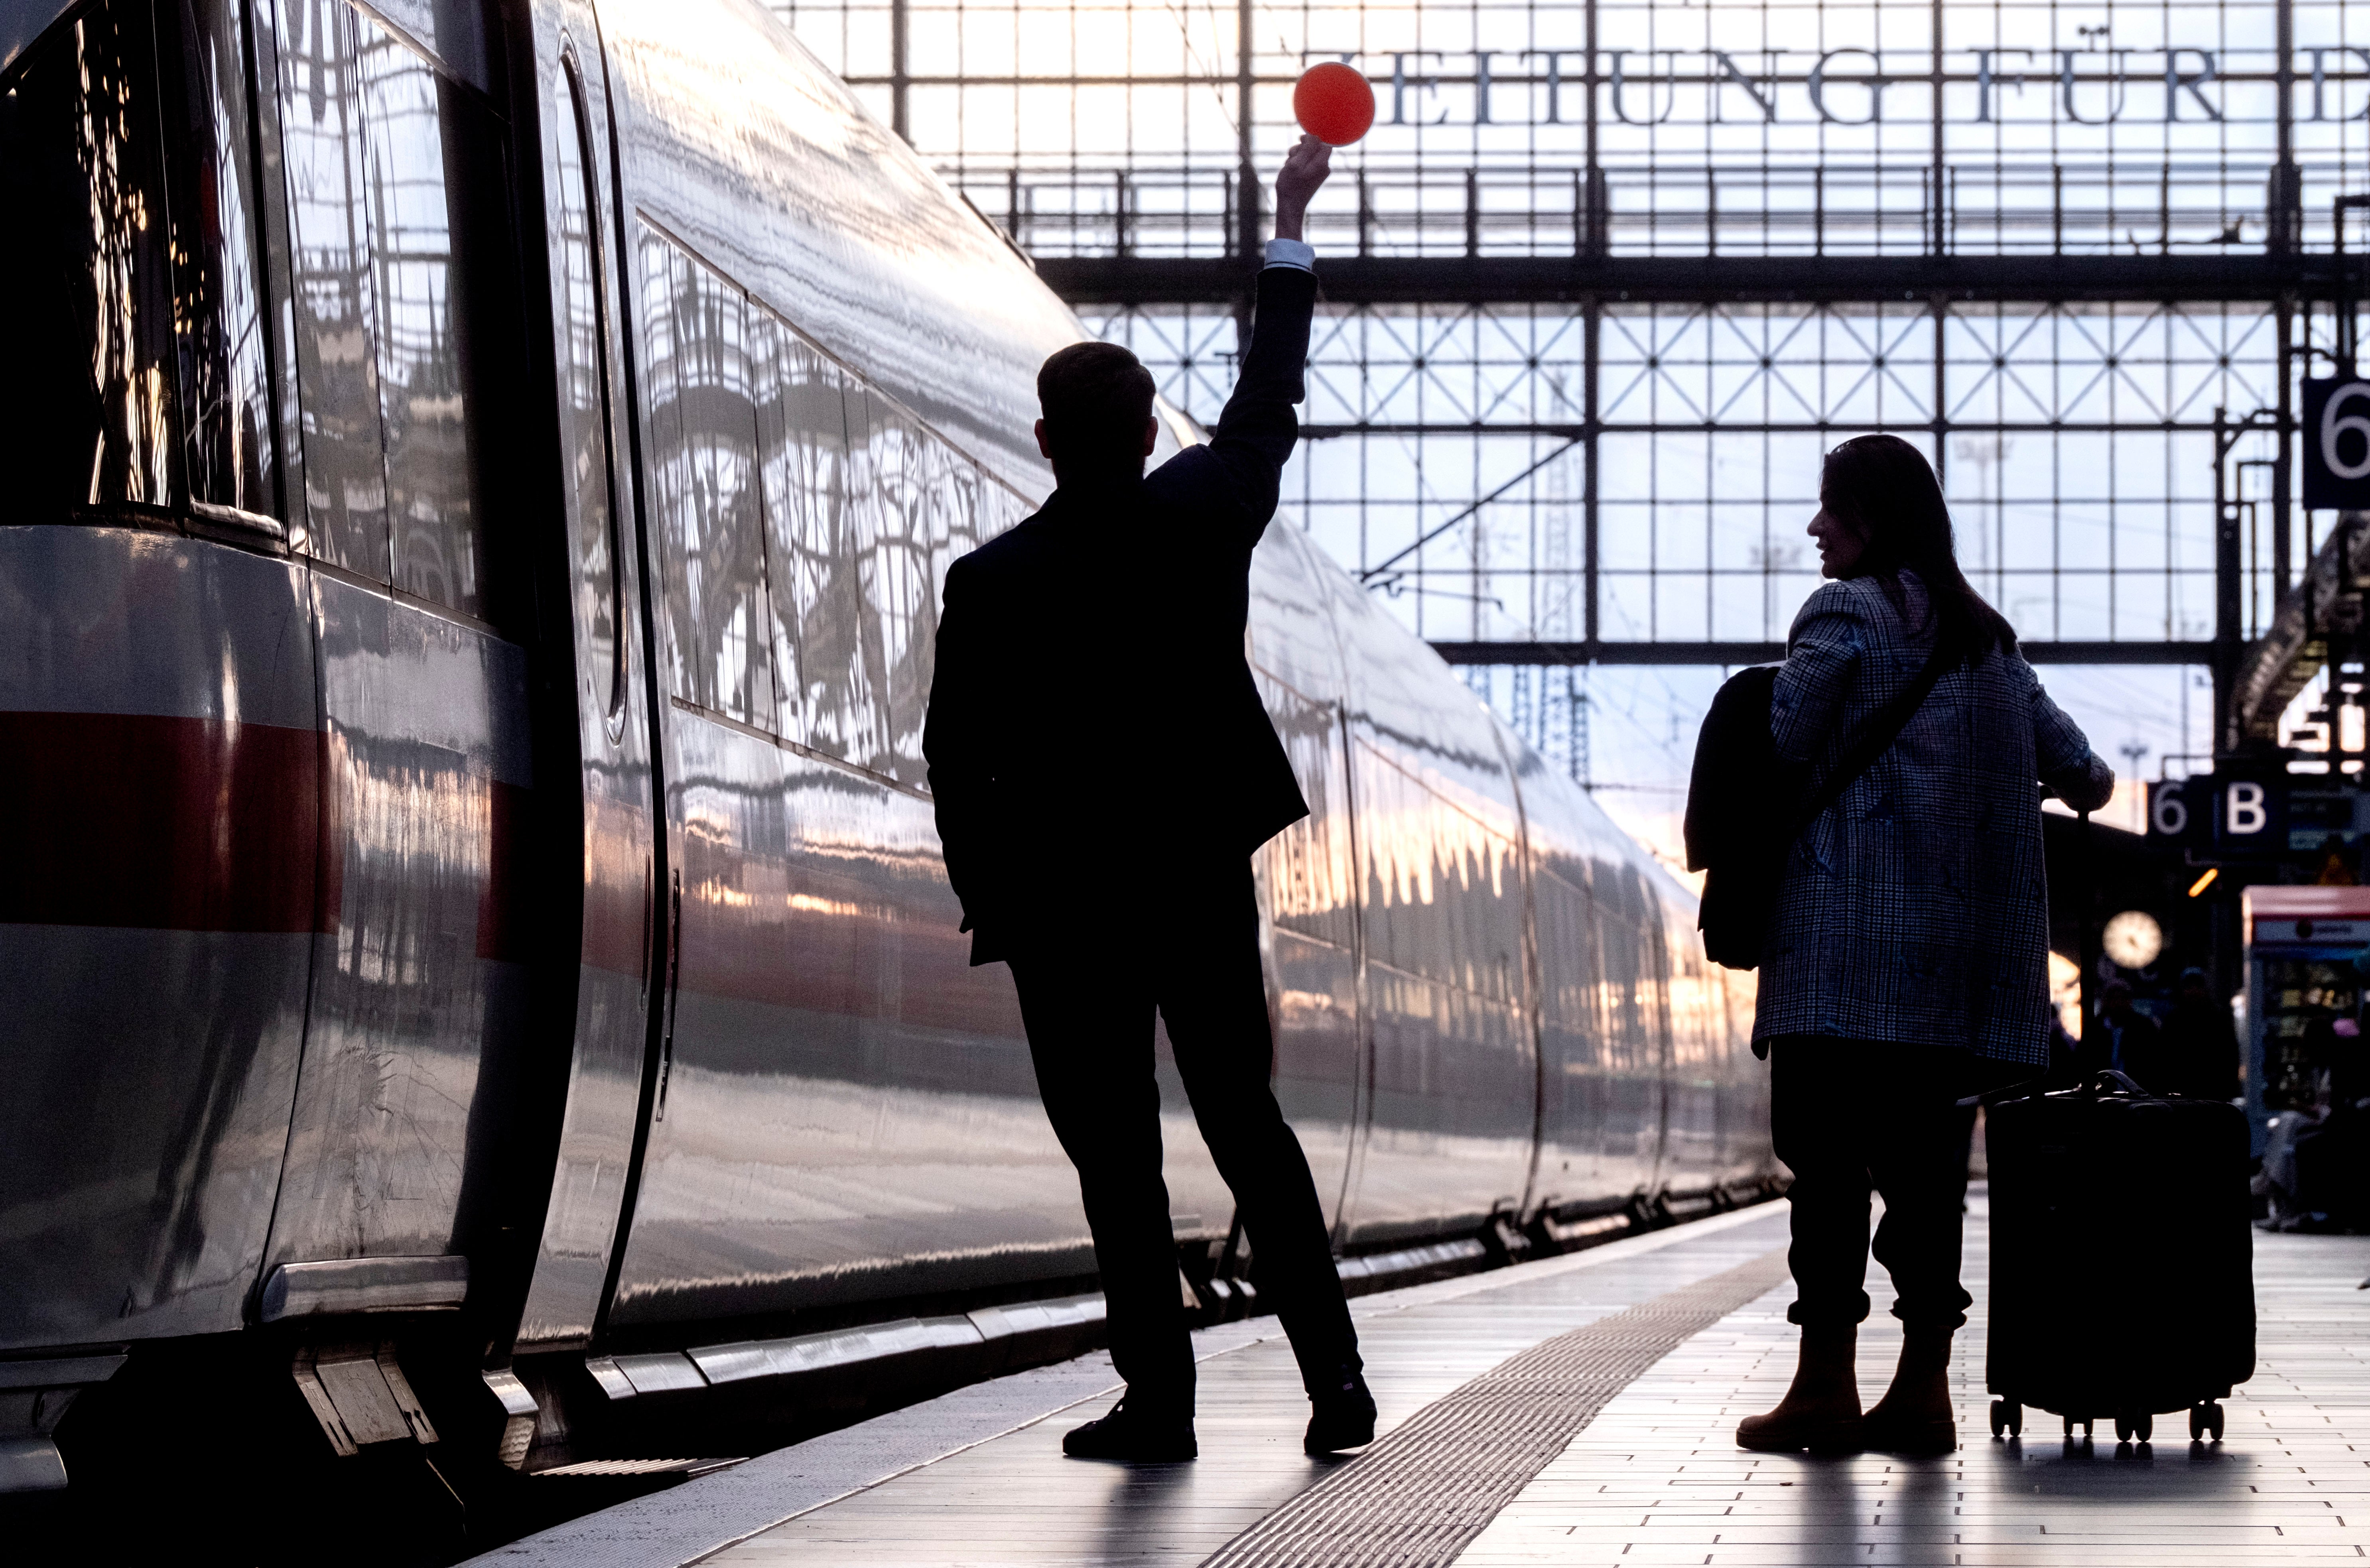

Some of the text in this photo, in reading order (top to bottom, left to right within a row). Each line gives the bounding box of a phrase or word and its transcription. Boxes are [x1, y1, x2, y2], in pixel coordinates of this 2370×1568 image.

[1301, 49, 1893, 124] EITUNG
[1967, 26, 2226, 124] FÜR
[2321, 382, 2370, 480] 6
[2153, 781, 2267, 836] 6 B
